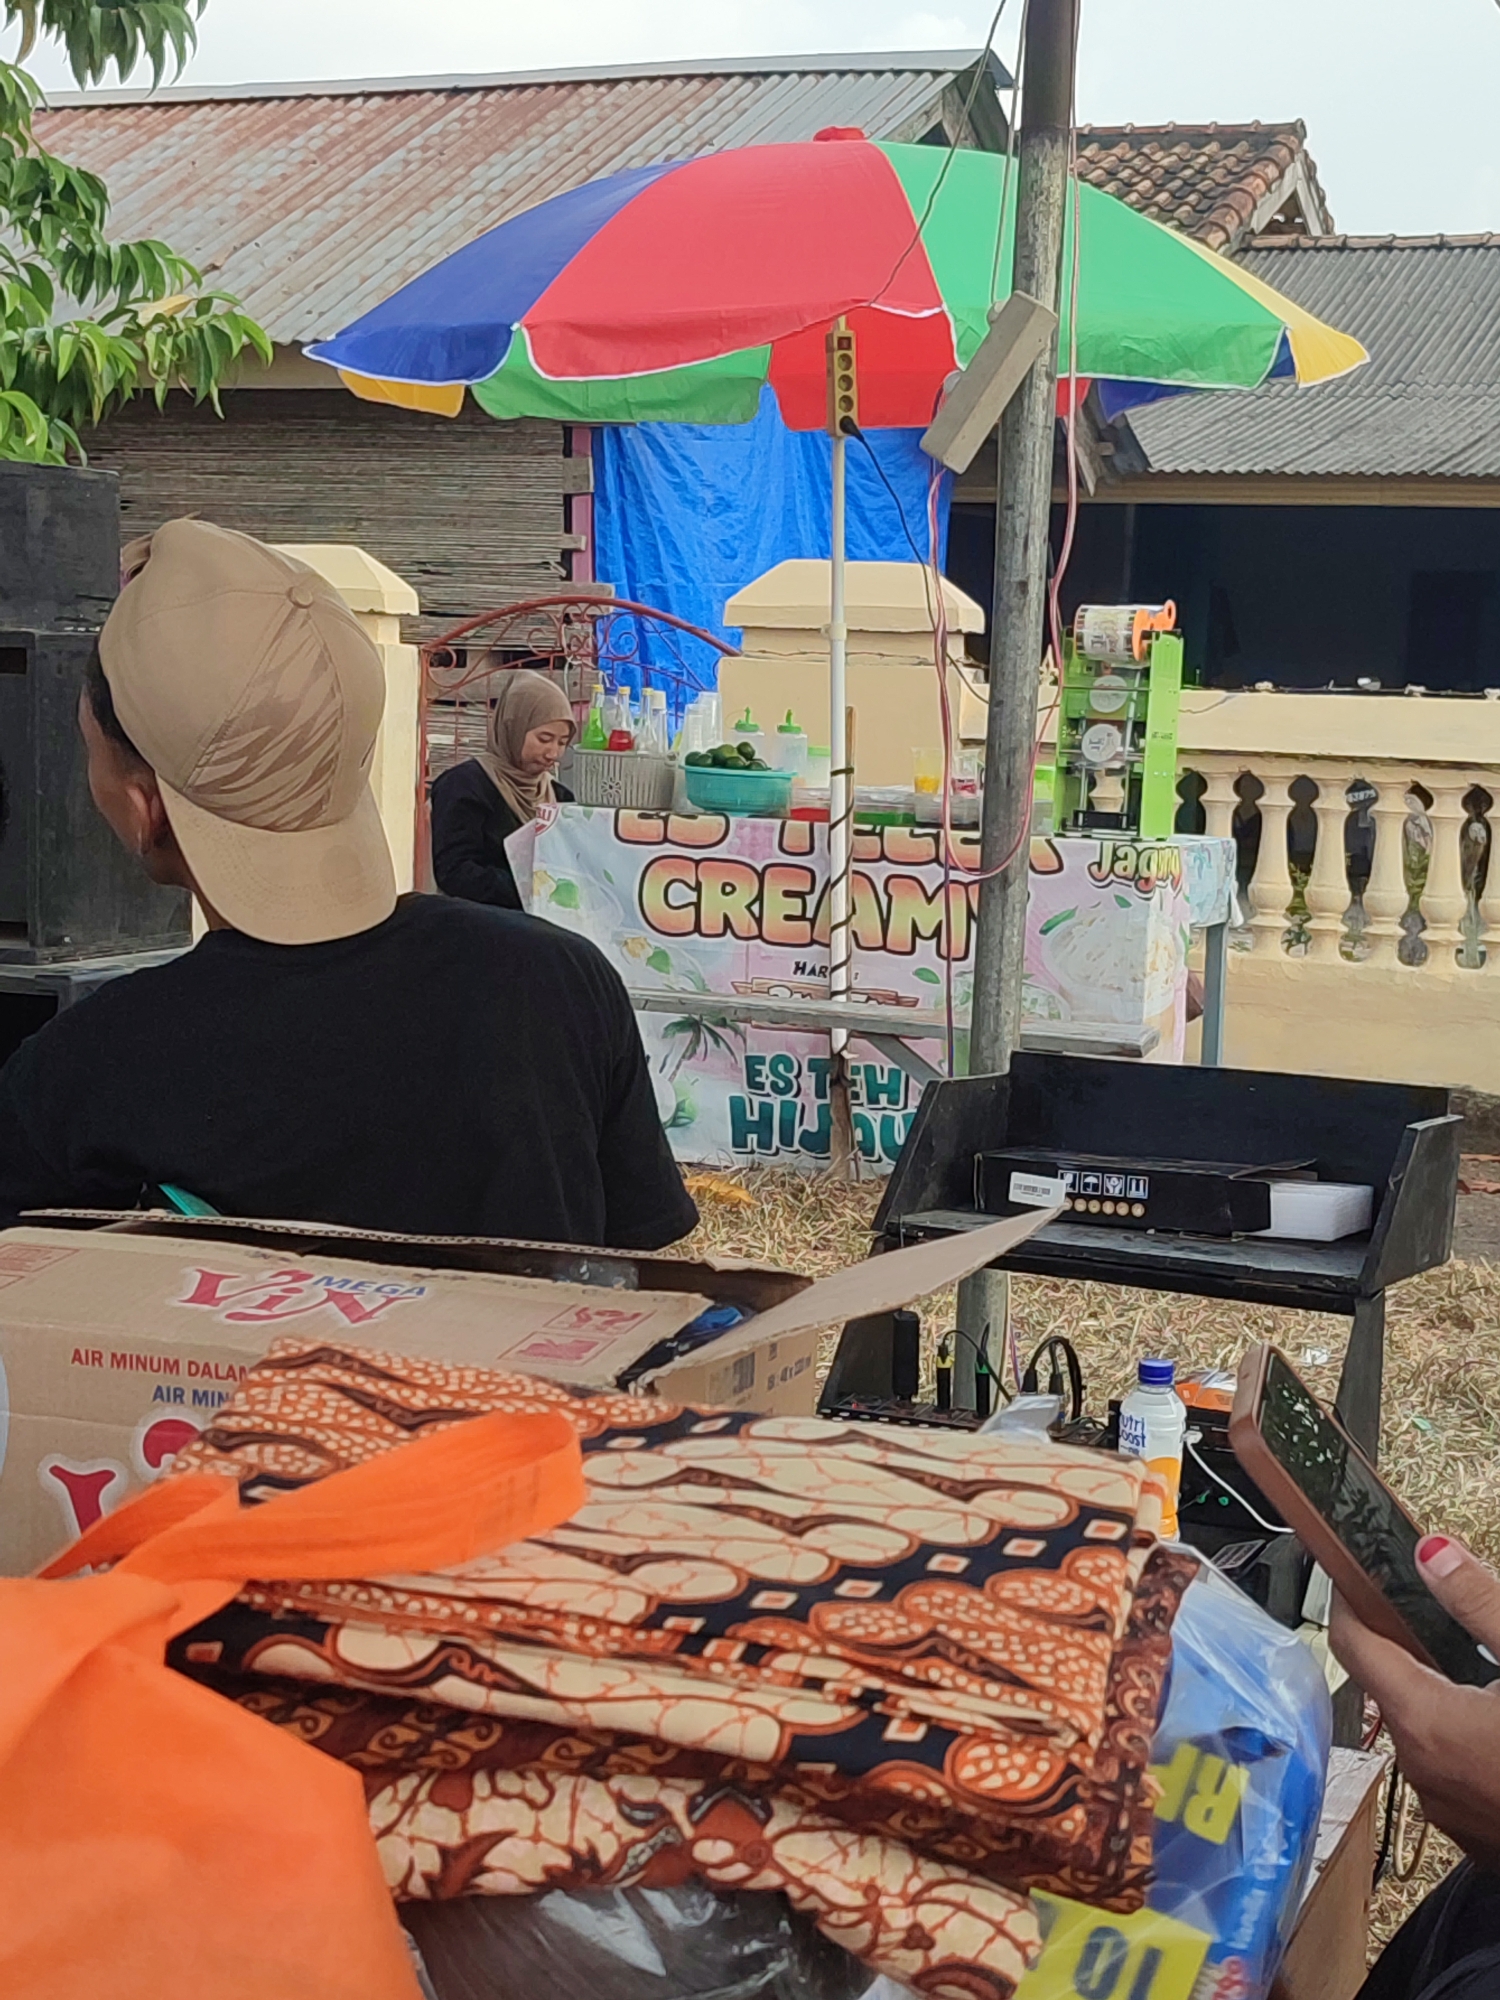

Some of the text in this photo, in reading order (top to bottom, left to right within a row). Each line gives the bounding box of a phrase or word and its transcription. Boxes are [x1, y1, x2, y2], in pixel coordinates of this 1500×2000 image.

[638, 854, 980, 961] CREAM
[744, 1053, 797, 1098] ES
[729, 1095, 920, 1163] HIJAU
[312, 1275, 428, 1297] MEGA
[71, 1348, 104, 1368] AIR
[110, 1352, 180, 1377] MINUM
[152, 1385, 230, 1409] AIR MIN
